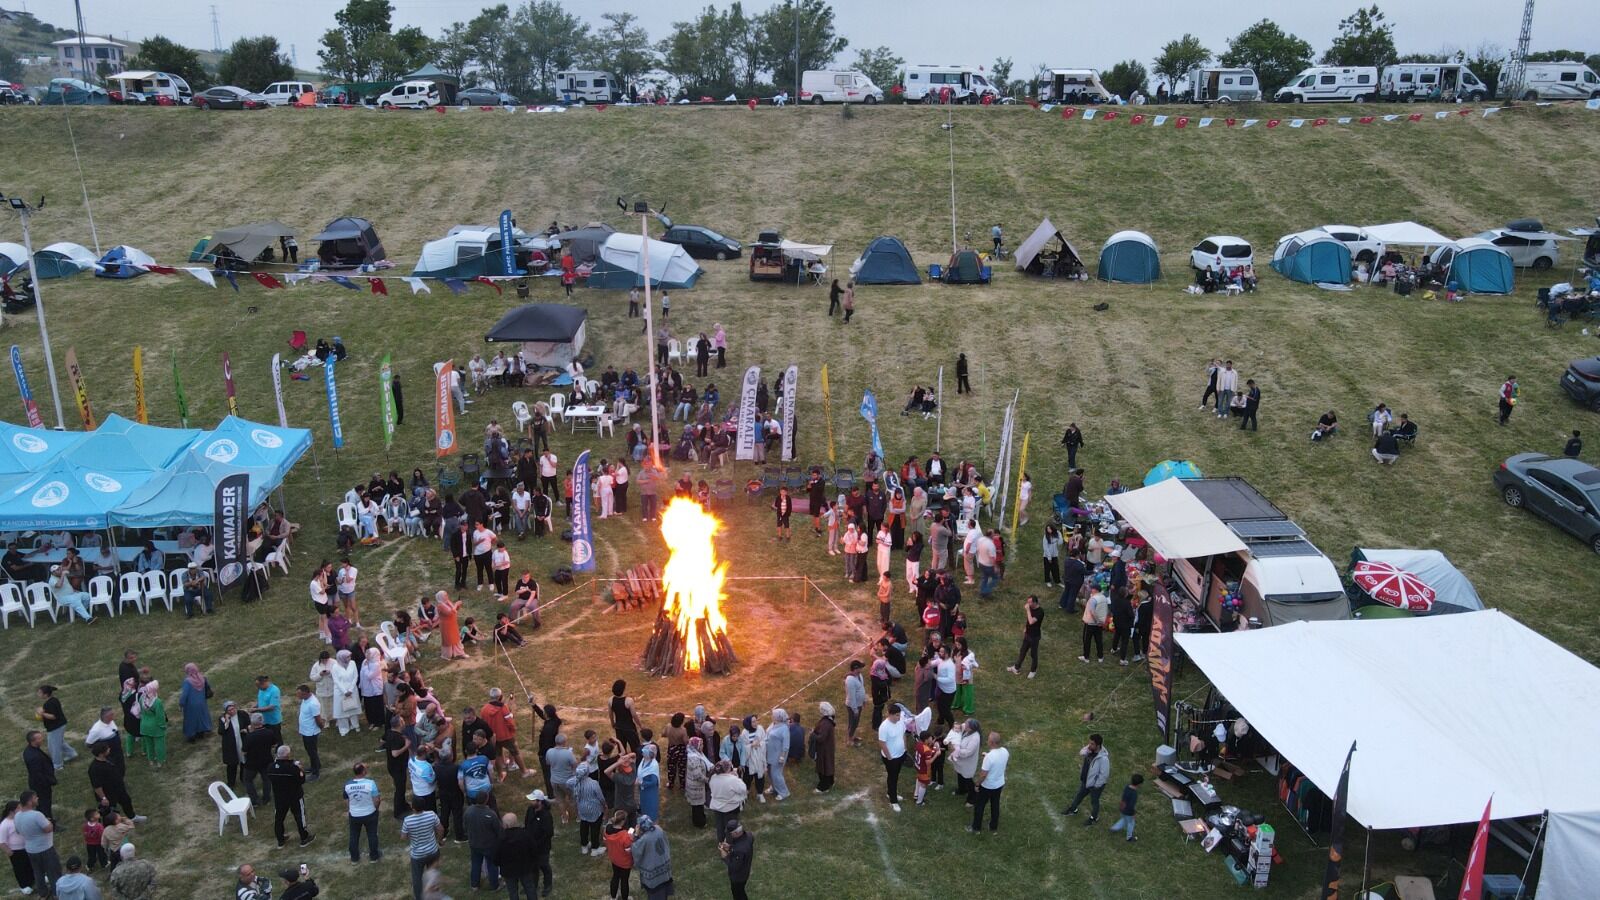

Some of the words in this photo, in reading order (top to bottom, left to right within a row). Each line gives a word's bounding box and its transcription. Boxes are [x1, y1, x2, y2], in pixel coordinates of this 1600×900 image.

[743, 388, 755, 450] ÇINARALTI
[223, 486, 236, 560] KAMADER
[573, 464, 582, 536] KAMADER
